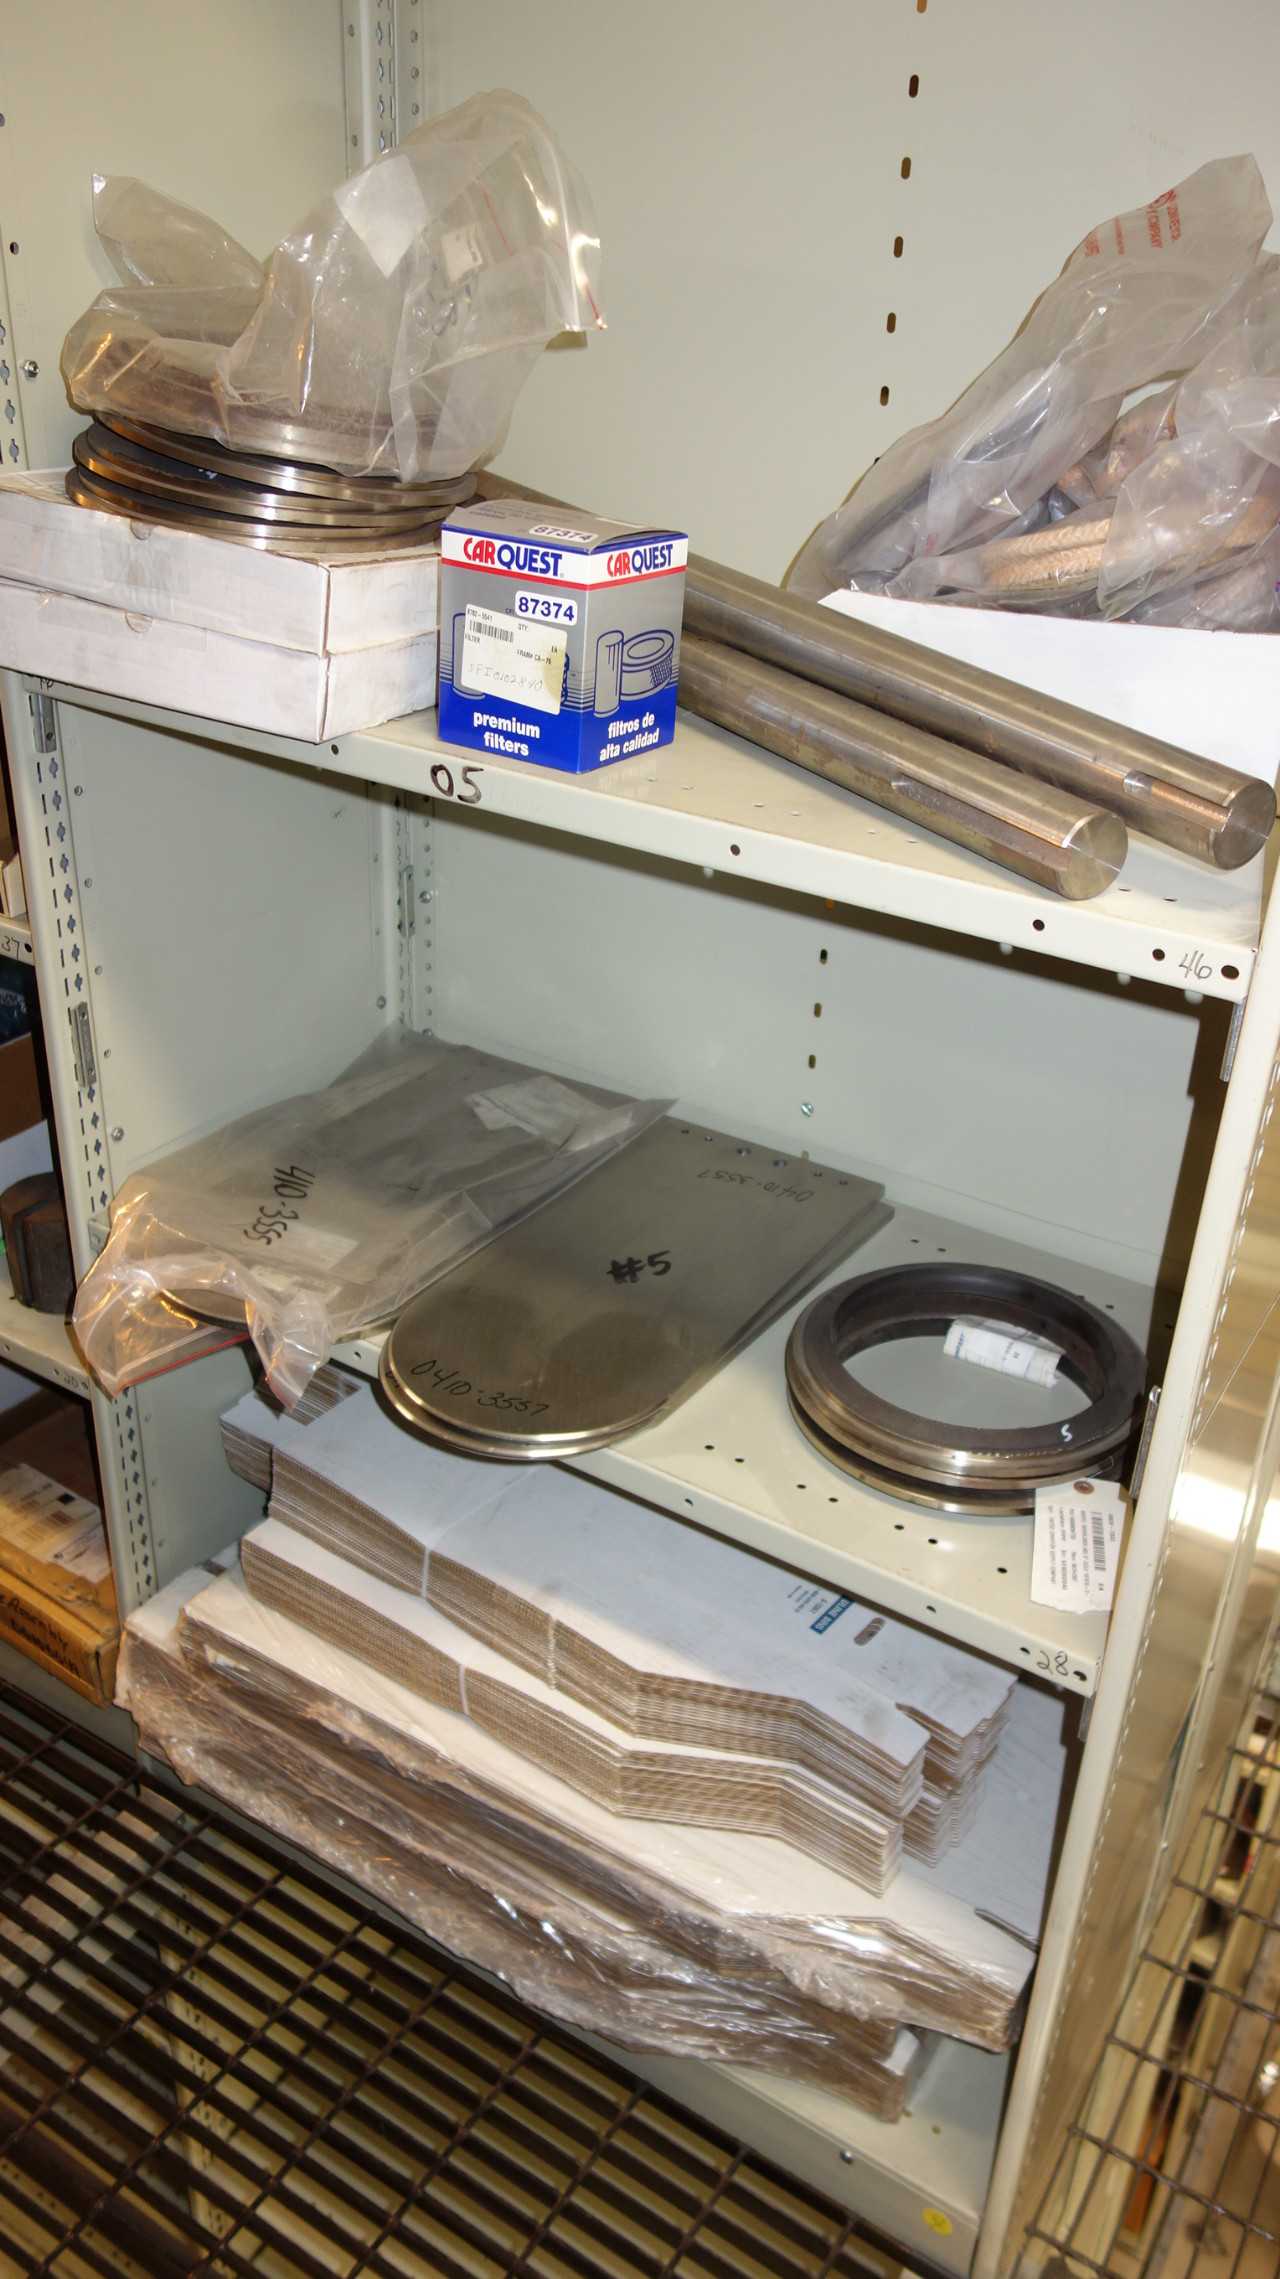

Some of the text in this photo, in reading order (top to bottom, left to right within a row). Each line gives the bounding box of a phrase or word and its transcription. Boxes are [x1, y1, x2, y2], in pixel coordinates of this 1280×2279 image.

[534, 526, 593, 542] 87374
[463, 537, 563, 577] CARQUEST
[607, 543, 673, 577] CARQUEST
[518, 596, 575, 621] 87374
[473, 710, 541, 738] premium
[607, 711, 655, 739] filtros de
[483, 731, 530, 757] filters
[599, 729, 660, 762] alta calidad
[1178, 950, 1213, 979] 46
[606, 1250, 672, 1285] #5
[1036, 1649, 1069, 1677] 28
